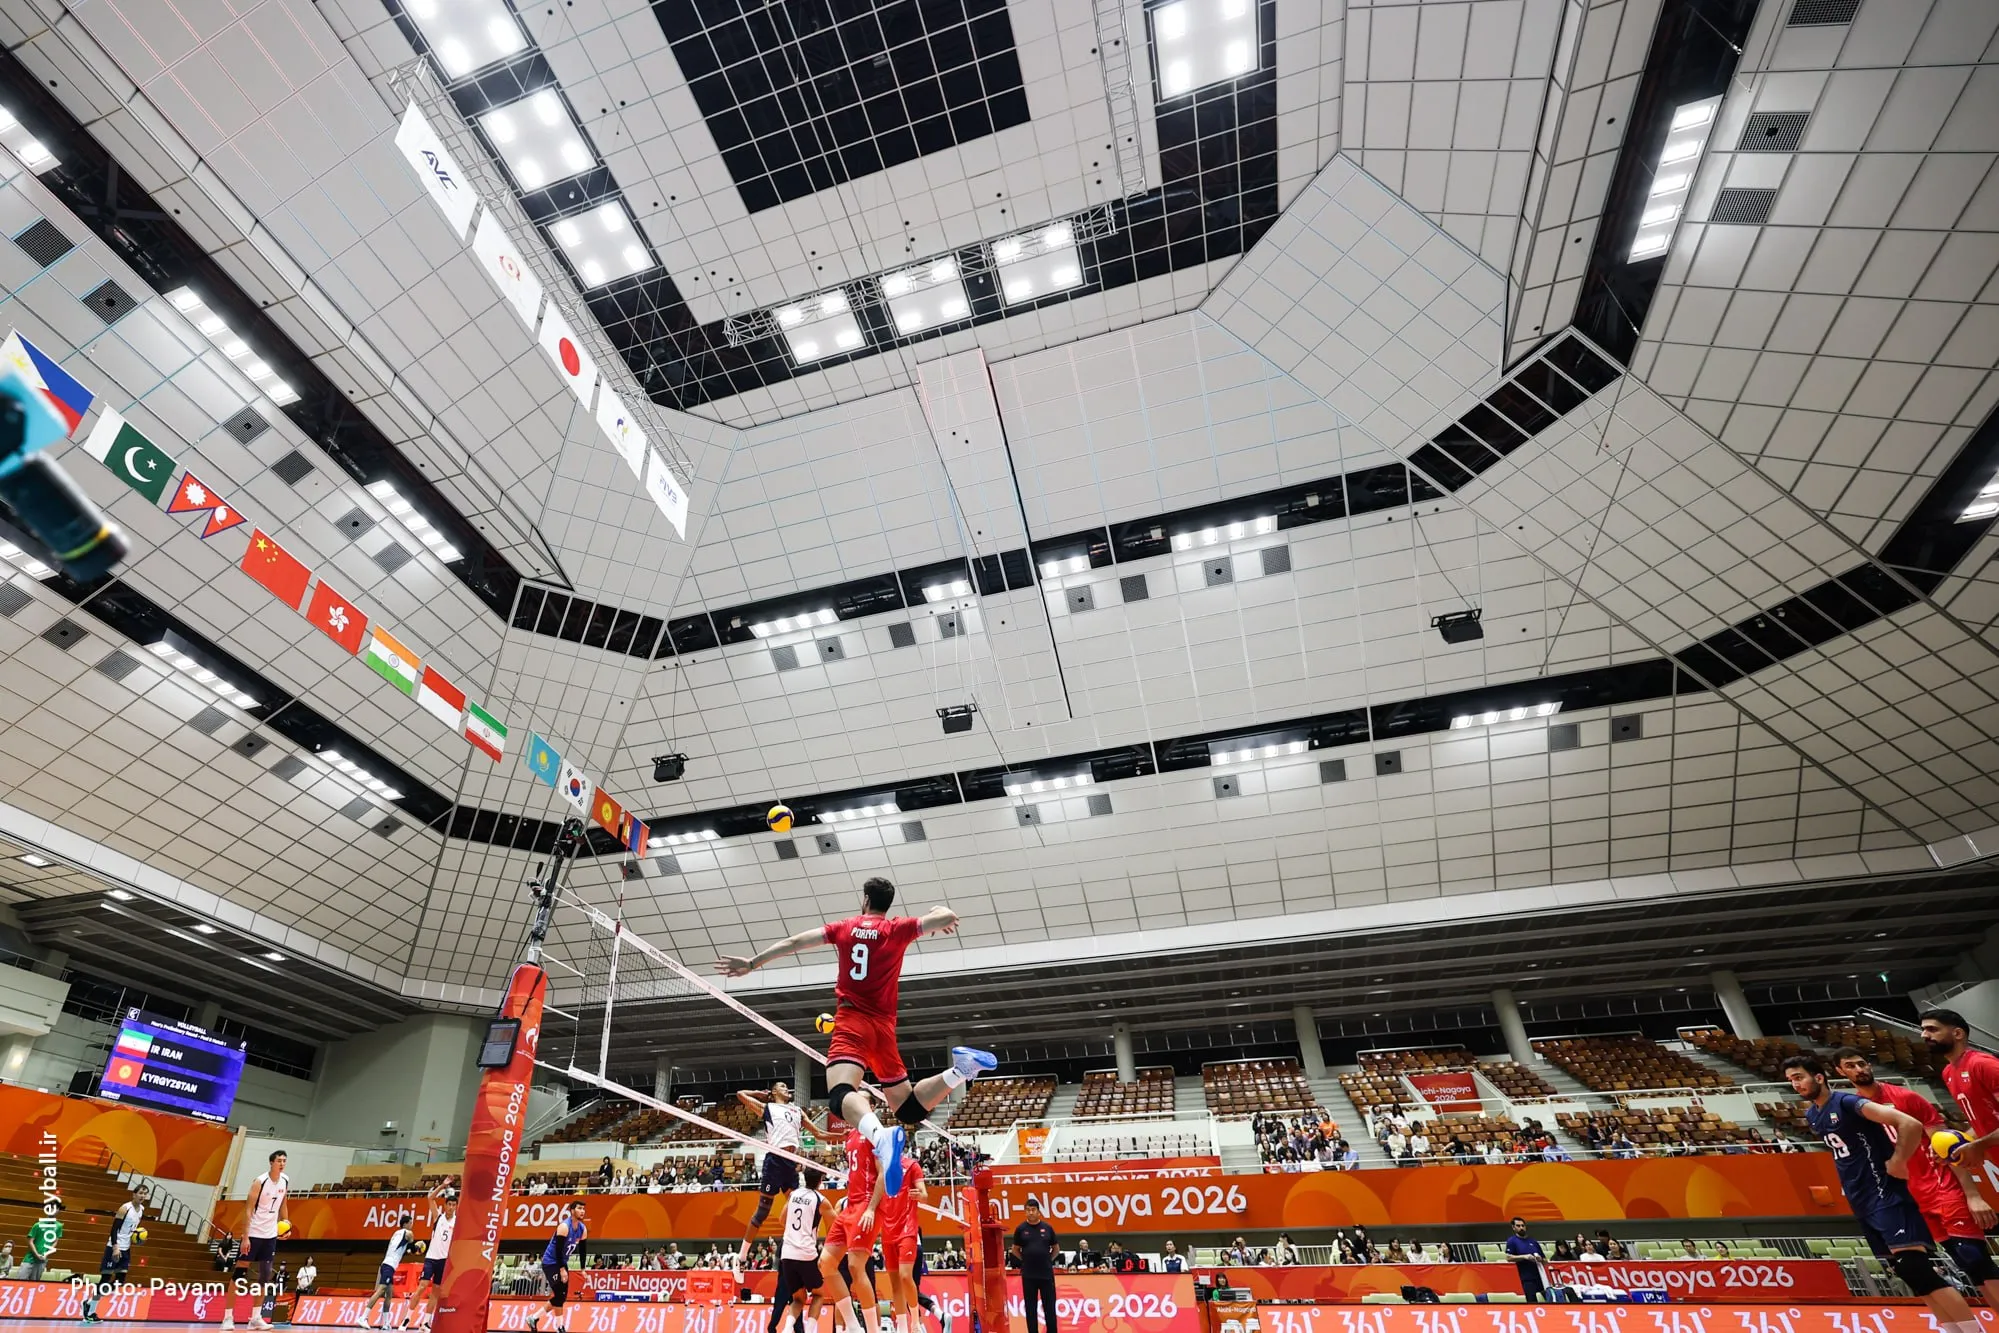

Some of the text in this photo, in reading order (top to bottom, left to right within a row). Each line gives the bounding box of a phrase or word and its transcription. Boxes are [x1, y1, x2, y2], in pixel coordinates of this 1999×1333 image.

[851, 927, 878, 940] PORIYA
[849, 943, 869, 981] 9
[177, 1021, 207, 1035] VOLLEYBALL
[150, 1044, 184, 1061] IR IRAN
[141, 1072, 198, 1094] KYRGYZSTAN
[1420, 1086, 1472, 1095] ichi-Nagoya
[1823, 1133, 1850, 1160] 19
[847, 1149, 858, 1171] 15
[481, 1130, 514, 1262] Aichi-Nagoya
[505, 1083, 525, 1126] 2026
[270, 1197, 277, 1211] 7
[515, 1203, 571, 1227] 2026
[936, 1185, 1247, 1227] Aii-Nagoya 2026
[792, 1208, 803, 1231] 3
[441, 1230, 448, 1242] 5
[566, 1243, 577, 1256] 17
[583, 1274, 687, 1295] Aichi-Nagoya
[1548, 1264, 1794, 1294] ichi-Nagoya 2026
[1108, 1294, 1178, 1318] 2026
